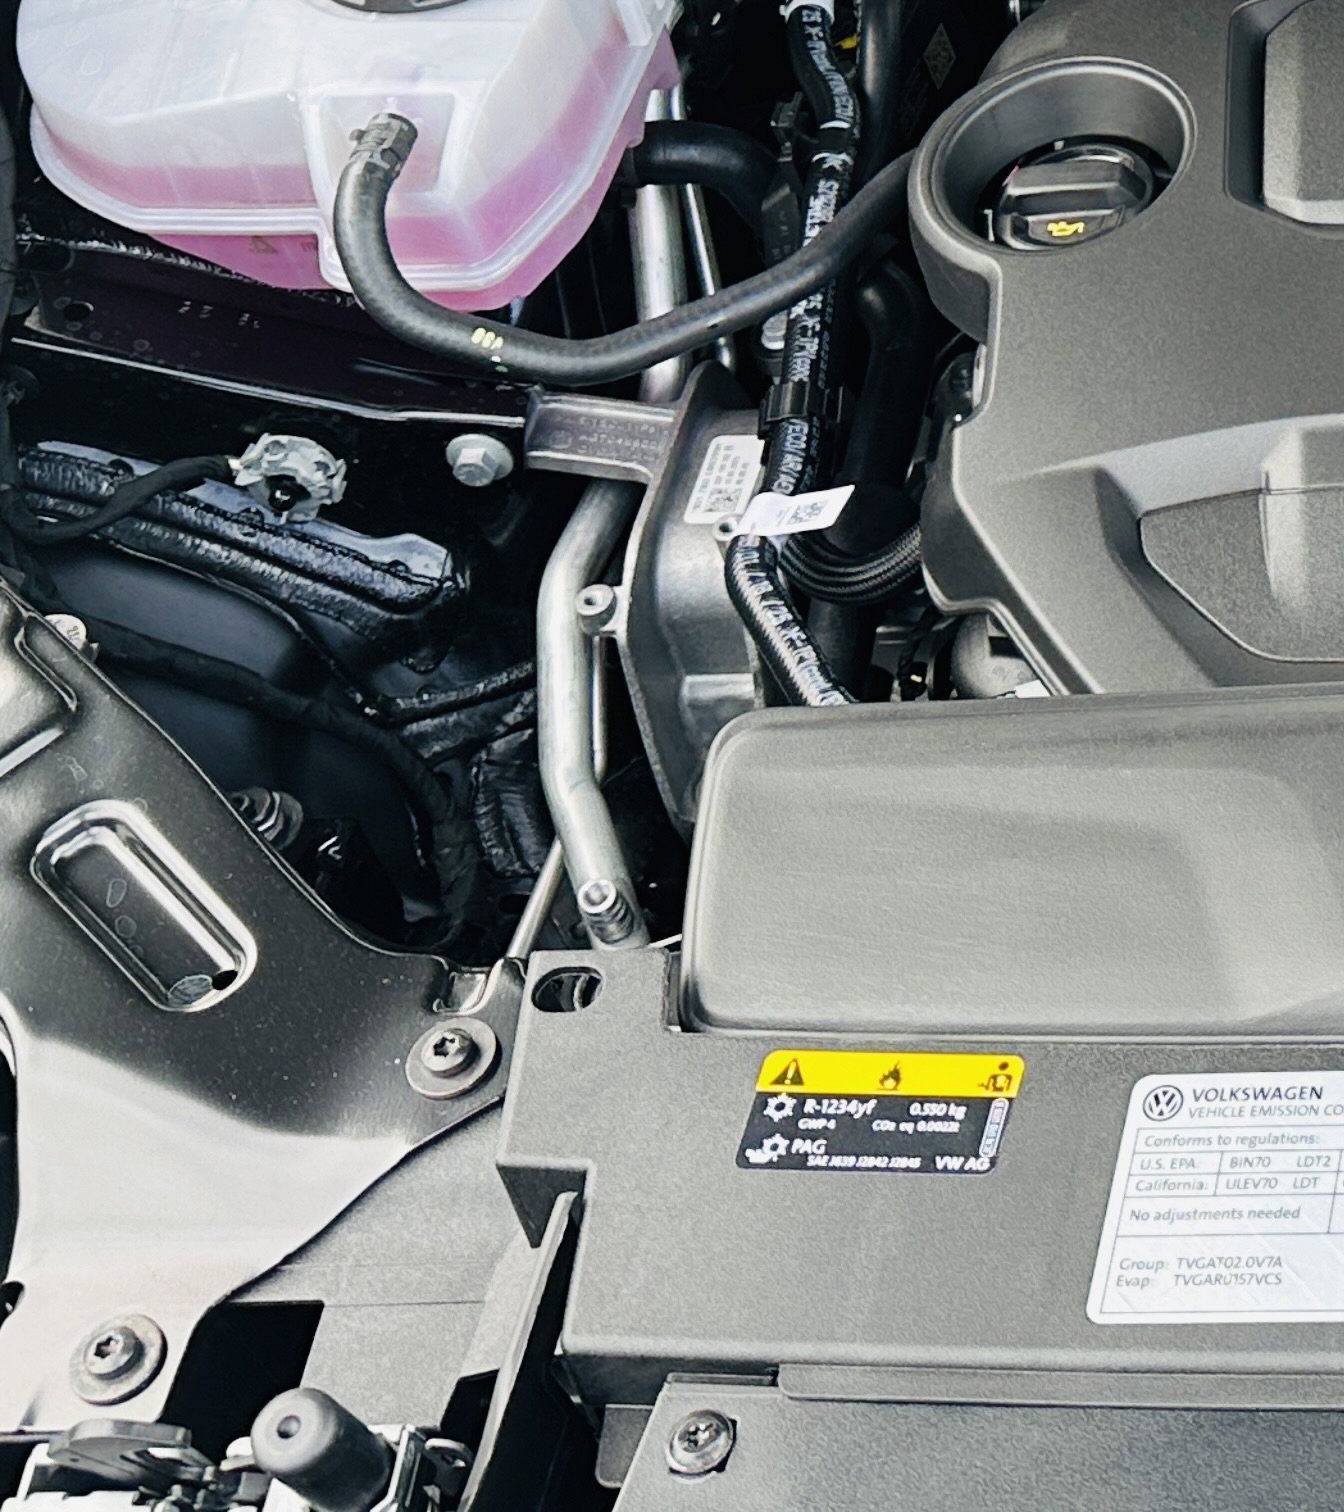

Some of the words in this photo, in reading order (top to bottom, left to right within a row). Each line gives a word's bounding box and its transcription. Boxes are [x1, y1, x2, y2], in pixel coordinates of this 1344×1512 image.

[1193, 1086, 1324, 1103] VOLKSWAGEN
[804, 1099, 877, 1119] R-1234yf
[948, 1103, 967, 1120] kg
[1189, 1107, 1246, 1119] VEHICLE
[1250, 1105, 1320, 1117] EMISSION
[791, 1139, 827, 1154] PAG
[1145, 1134, 1213, 1147] Conforms
[1217, 1136, 1231, 1145] to
[1236, 1133, 1319, 1148] regulations:
[935, 1156, 964, 1170] VW
[964, 1156, 991, 1171] AG
[1140, 1159, 1166, 1170] U.S.
[1229, 1156, 1271, 1168] BIN70
[1297, 1155, 1331, 1168] LDT2
[1226, 1177, 1278, 1189] ULEV70
[1293, 1177, 1319, 1188] LDT
[1130, 1209, 1150, 1221] No
[1153, 1208, 1243, 1224] adjustments
[1247, 1206, 1301, 1219] needed
